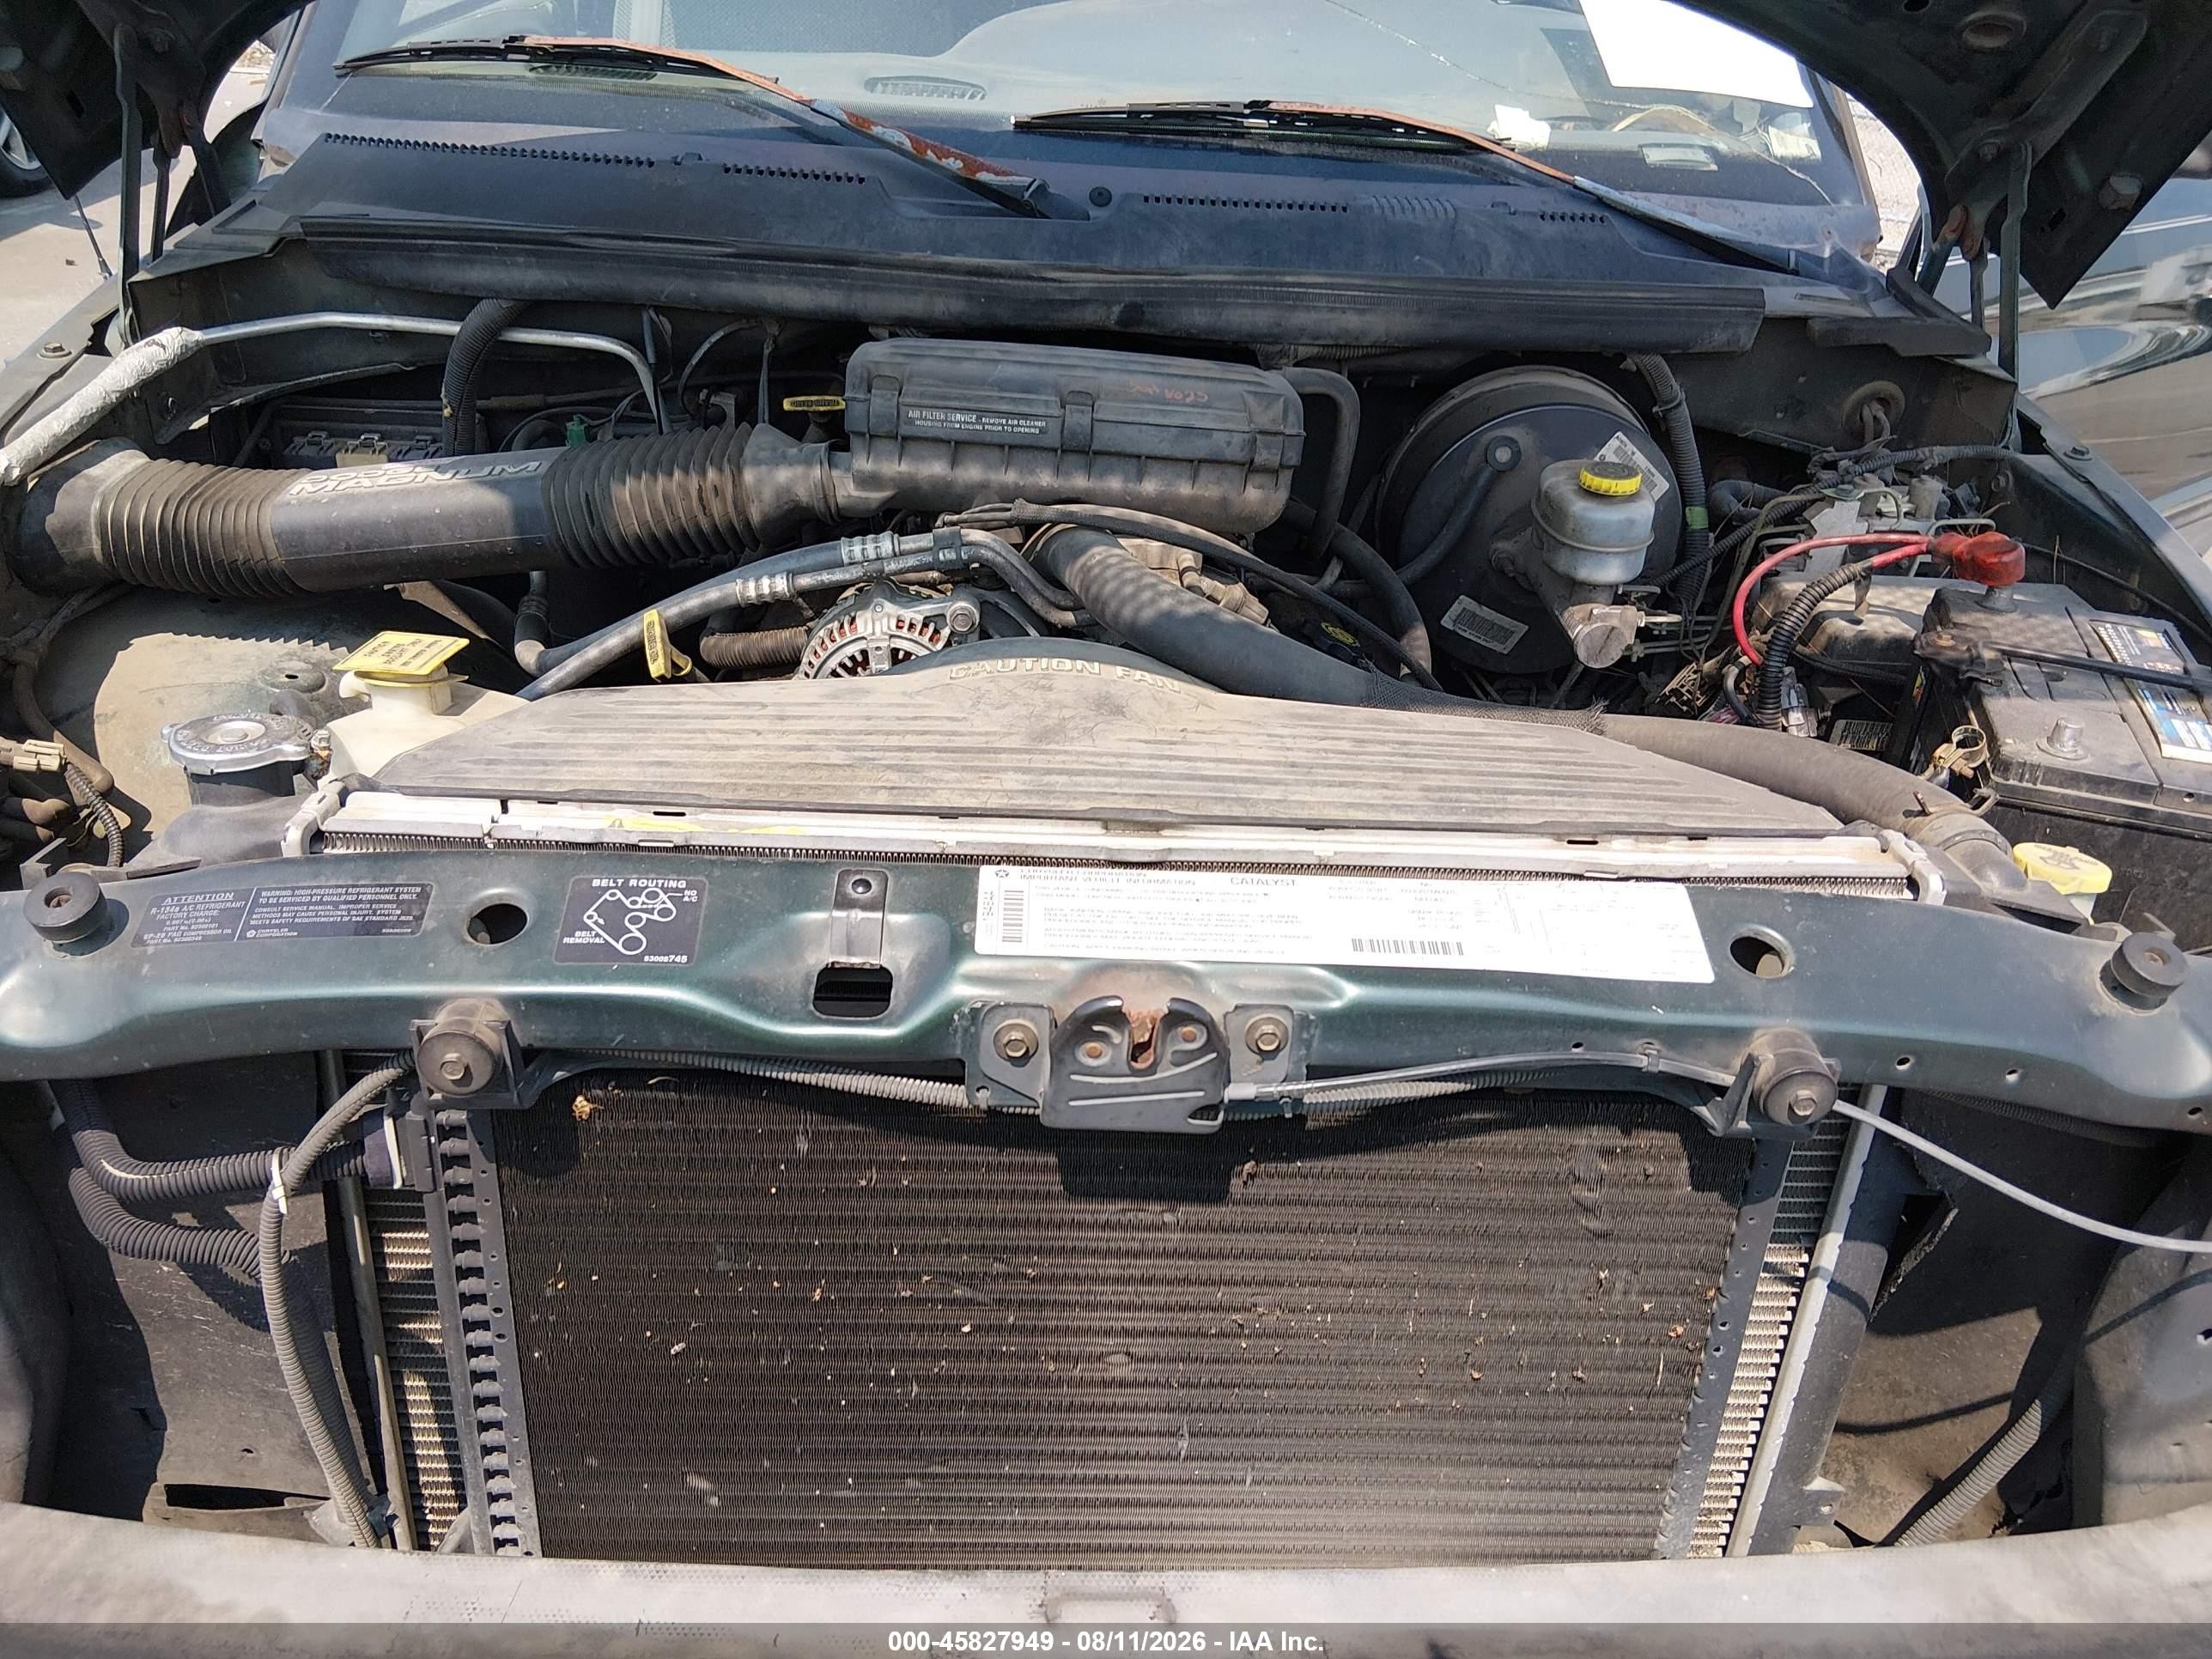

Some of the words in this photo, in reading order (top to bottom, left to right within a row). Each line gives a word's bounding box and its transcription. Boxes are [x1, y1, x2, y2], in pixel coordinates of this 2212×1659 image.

[922, 411, 945, 420] FILTER
[947, 413, 976, 422] SERVICE
[289, 461, 542, 495] MAGNUM
[949, 658, 1101, 679] CAUTION
[1115, 665, 1182, 694] FAN
[629, 879, 687, 888] ROUTING
[1230, 878, 1297, 886] CATALYST
[163, 893, 234, 903] ATTENTION
[195, 902, 246, 910] REFRIGERANT
